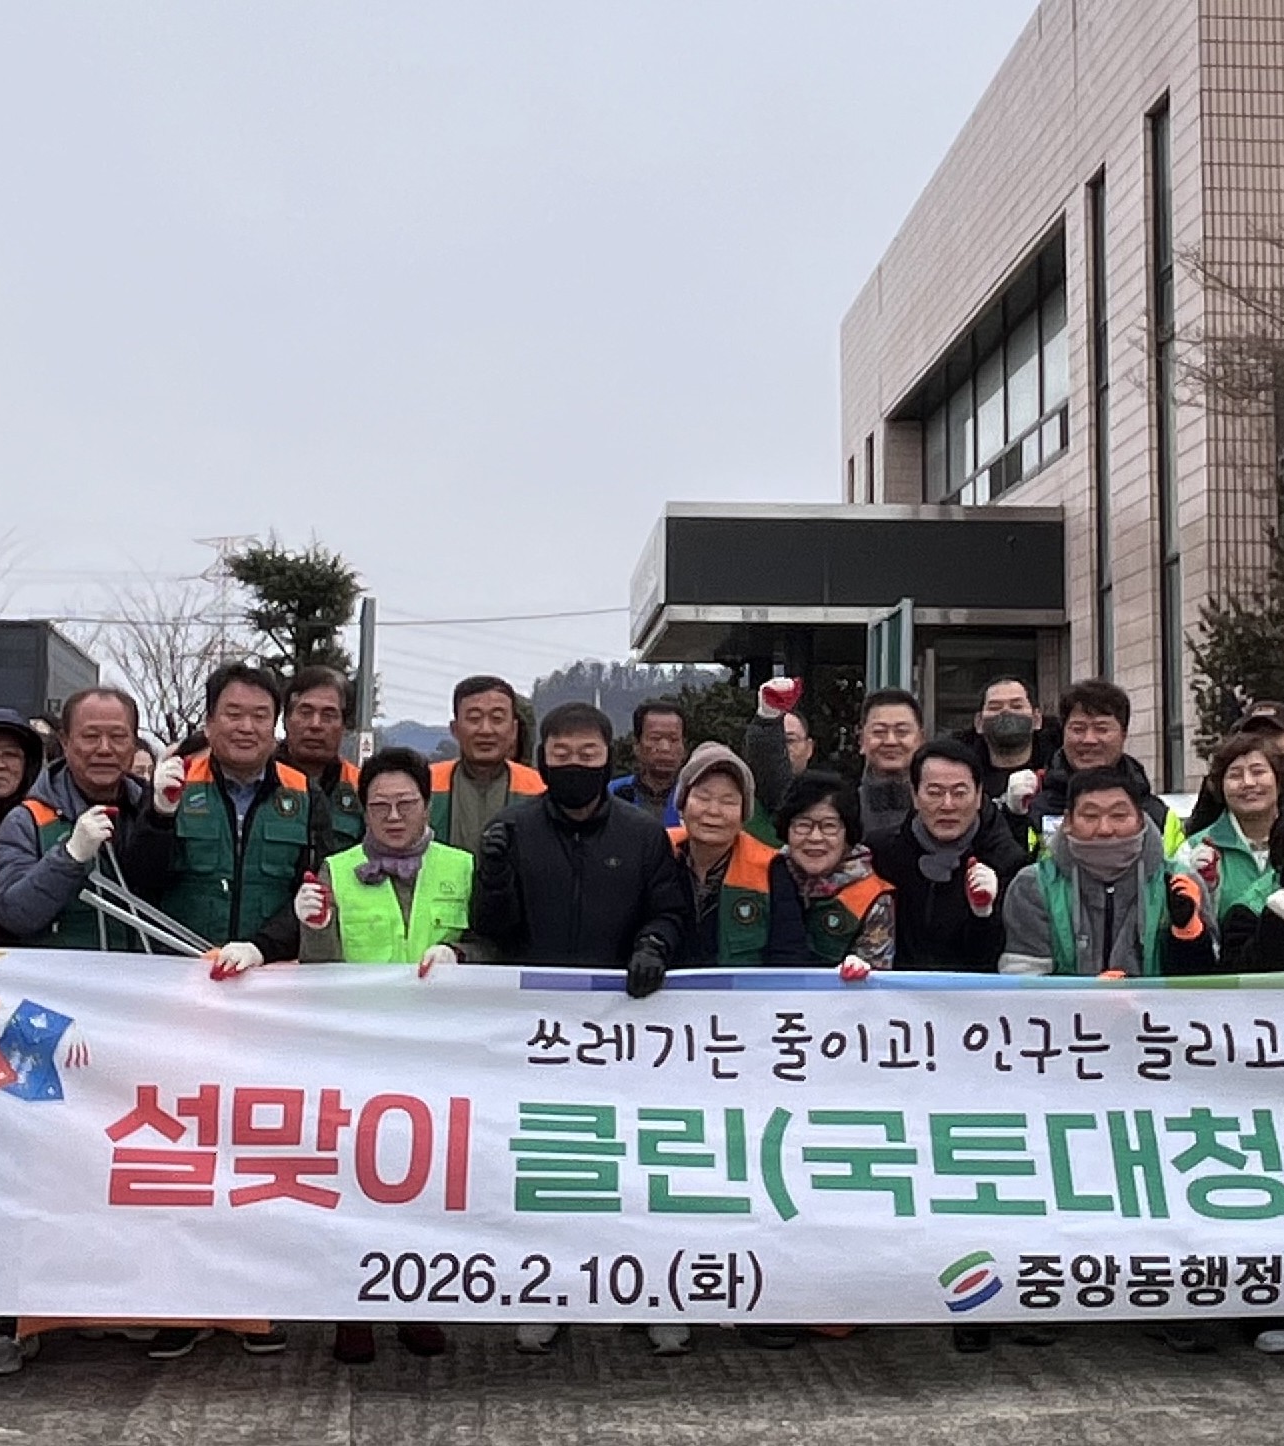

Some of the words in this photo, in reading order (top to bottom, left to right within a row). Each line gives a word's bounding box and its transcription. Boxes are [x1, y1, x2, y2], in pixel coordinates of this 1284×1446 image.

[527, 1014, 746, 1080] 쓰레기는
[771, 1012, 937, 1082] 줄이고!
[963, 1012, 1111, 1080] 인구는
[105, 1084, 471, 1212] 설맞이
[357, 1249, 764, 1309] 2026.2.10.(화)
